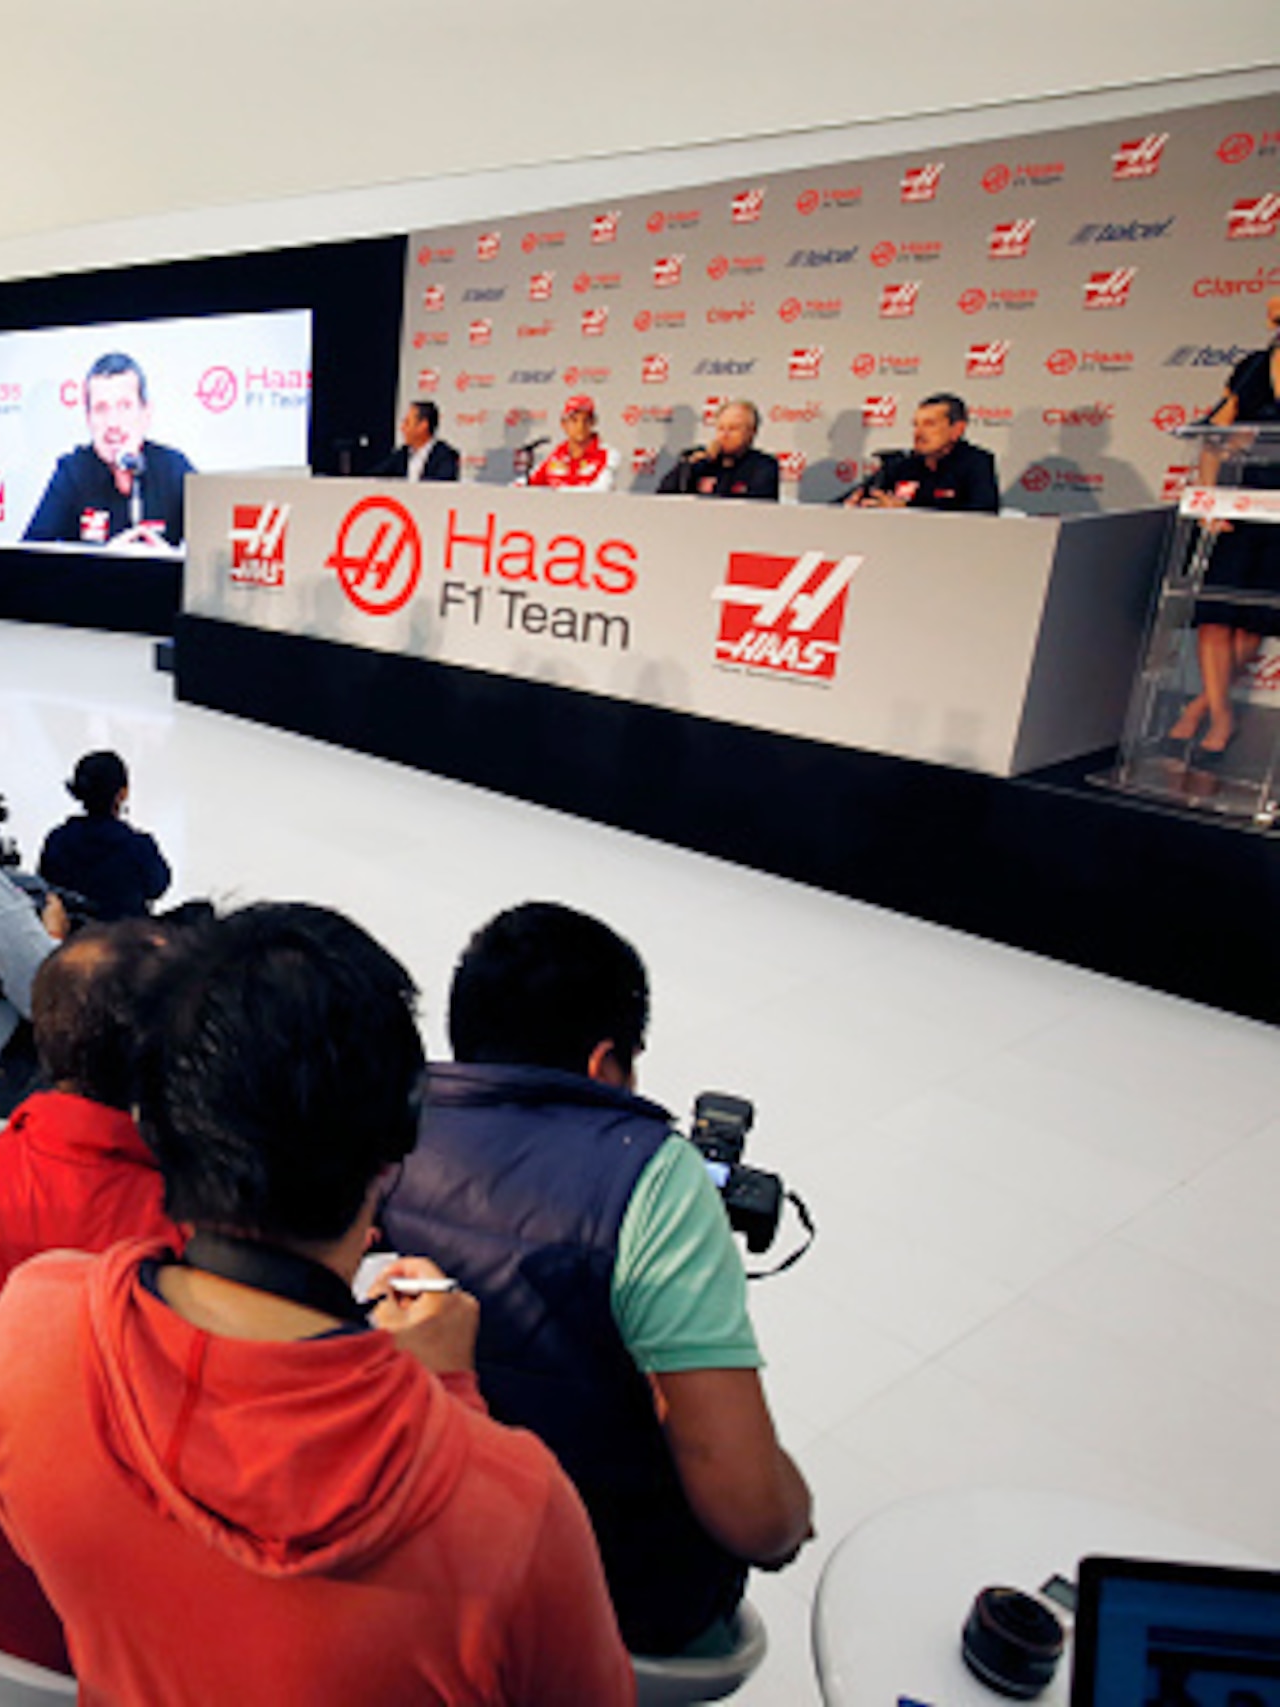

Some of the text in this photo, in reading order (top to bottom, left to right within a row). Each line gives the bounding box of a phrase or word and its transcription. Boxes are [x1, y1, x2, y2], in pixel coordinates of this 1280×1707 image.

[443, 508, 638, 595] Haas
[439, 581, 631, 651] F1 Team
[715, 630, 841, 672] HAAS
